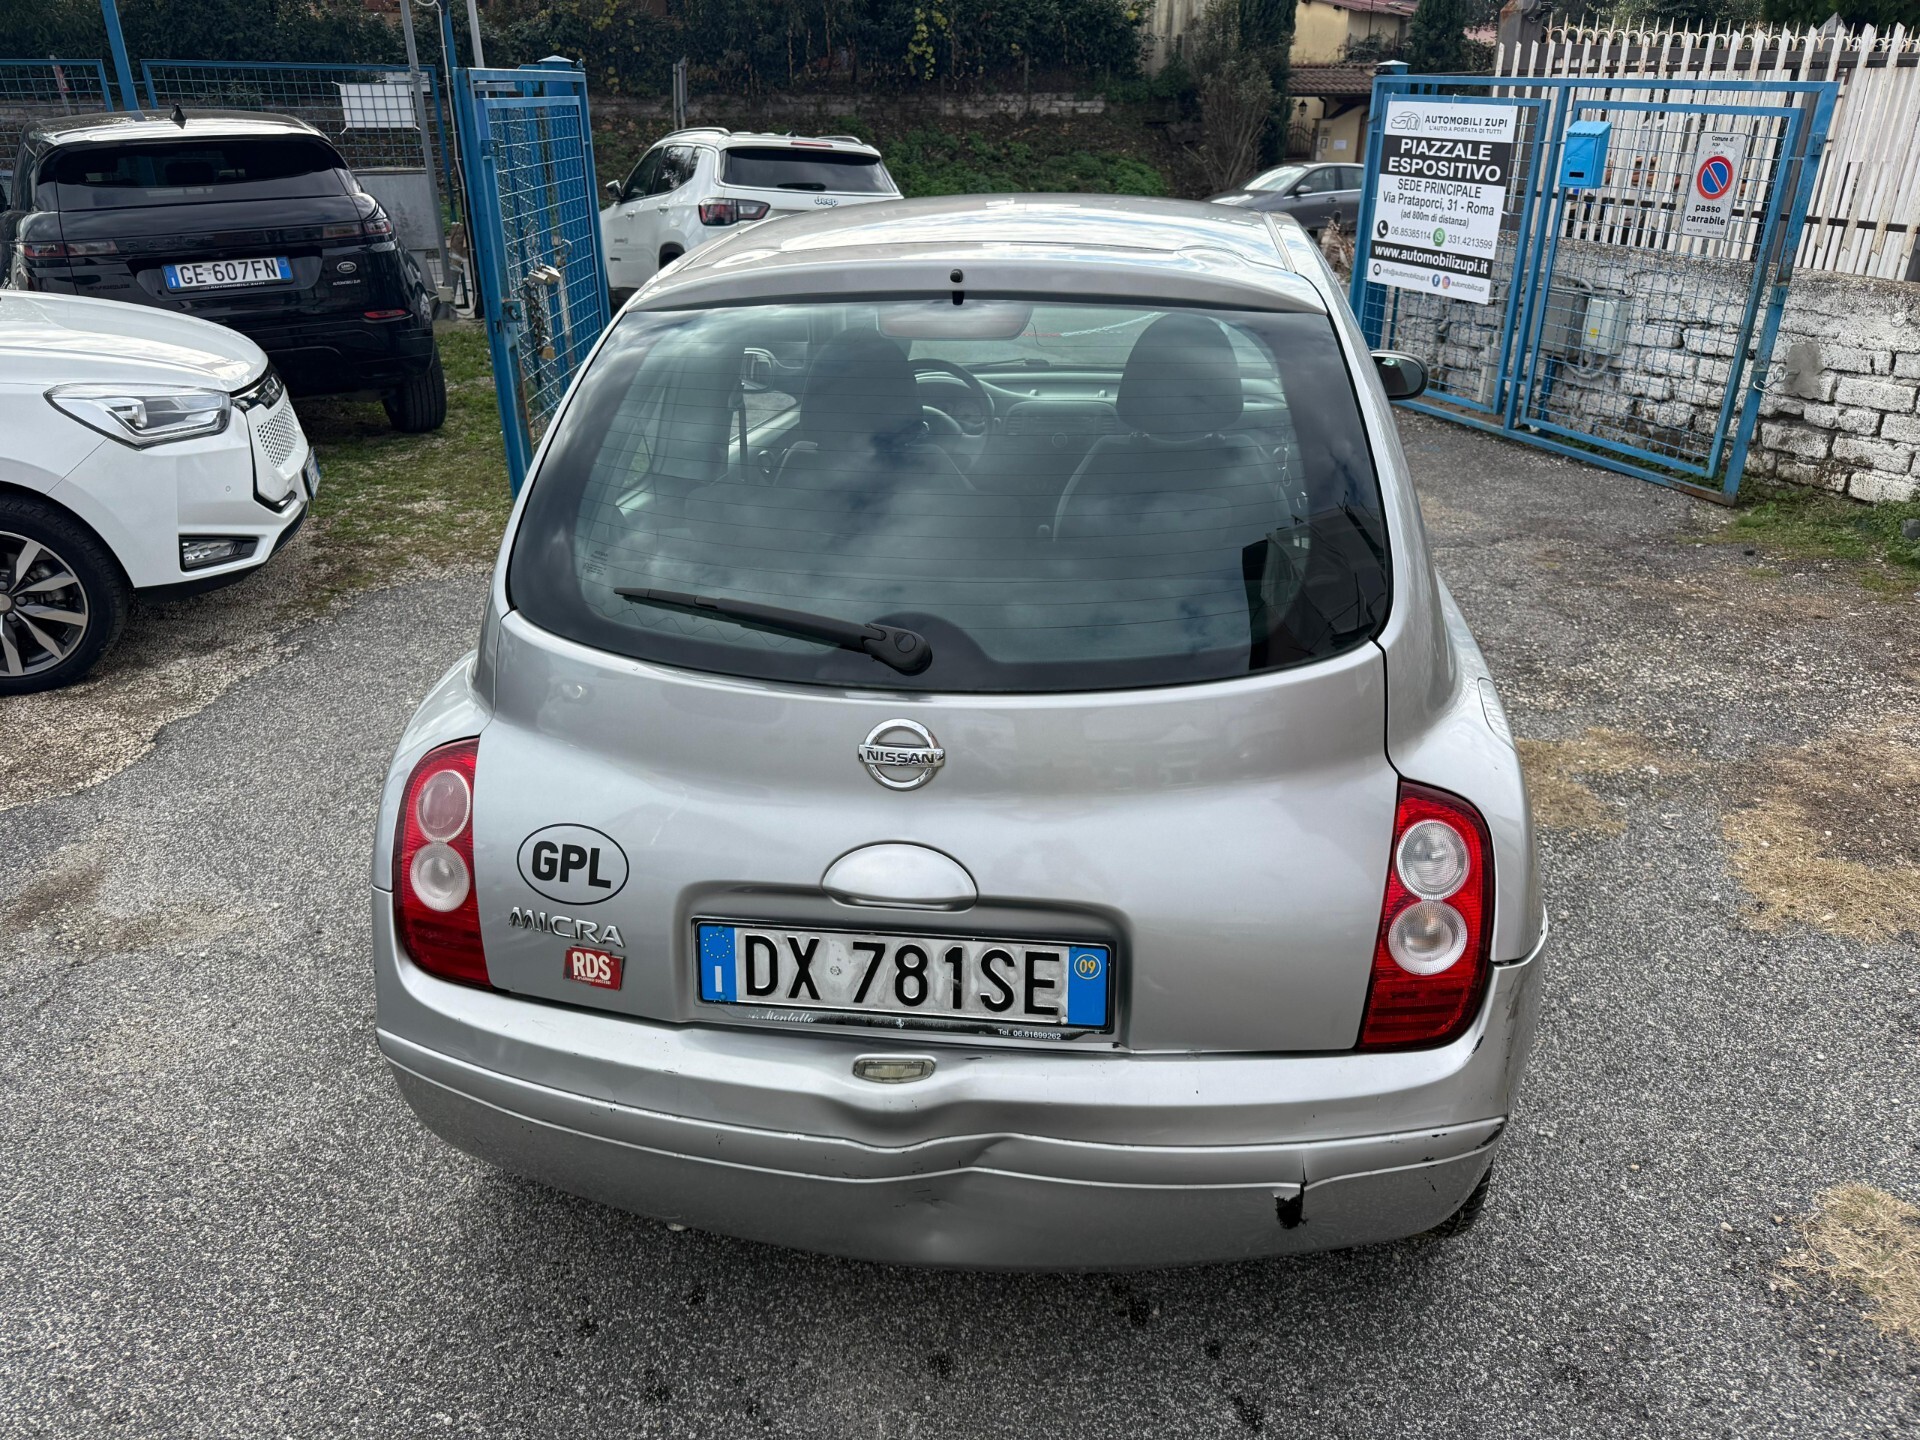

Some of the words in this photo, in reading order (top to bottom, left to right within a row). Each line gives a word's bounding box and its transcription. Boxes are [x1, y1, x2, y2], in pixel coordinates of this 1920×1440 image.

[1424, 115, 1482, 127] AUTOMOBILI
[1484, 117, 1508, 128] ZUPI
[1453, 126, 1478, 134] PORTATA
[1400, 139, 1493, 161] PIAZZALE
[1387, 157, 1501, 182] ESPOSITIVO
[1397, 178, 1423, 193] SEDE
[1424, 181, 1482, 199] PRINCIPALE
[814, 195, 839, 208] Jeep
[1383, 191, 1397, 204] Via
[1398, 193, 1445, 212] Prataporci,
[1446, 199, 1460, 212] 31
[1466, 200, 1495, 216] Roma
[1694, 203, 1721, 213] passo
[1400, 209, 1411, 220] (ad
[1412, 211, 1429, 222] 800m
[1430, 213, 1438, 223] di
[1438, 214, 1470, 229] distanza)
[1686, 214, 1726, 226] carrabile
[1390, 226, 1431, 240] 06.85385114
[1447, 234, 1493, 250] 331.4213599
[1374, 245, 1489, 275] www.automobilizupi.it
[179, 264, 207, 285] GE
[211, 259, 278, 282] 607FN
[866, 749, 935, 764] NISSAN
[531, 840, 612, 889] GPL
[508, 906, 625, 948] MICRA
[572, 951, 612, 981] RDS
[744, 932, 822, 1001] DX
[851, 941, 1061, 1016] 781SE
[1079, 959, 1097, 974] 09
[997, 1028, 1011, 1036] Tel.
